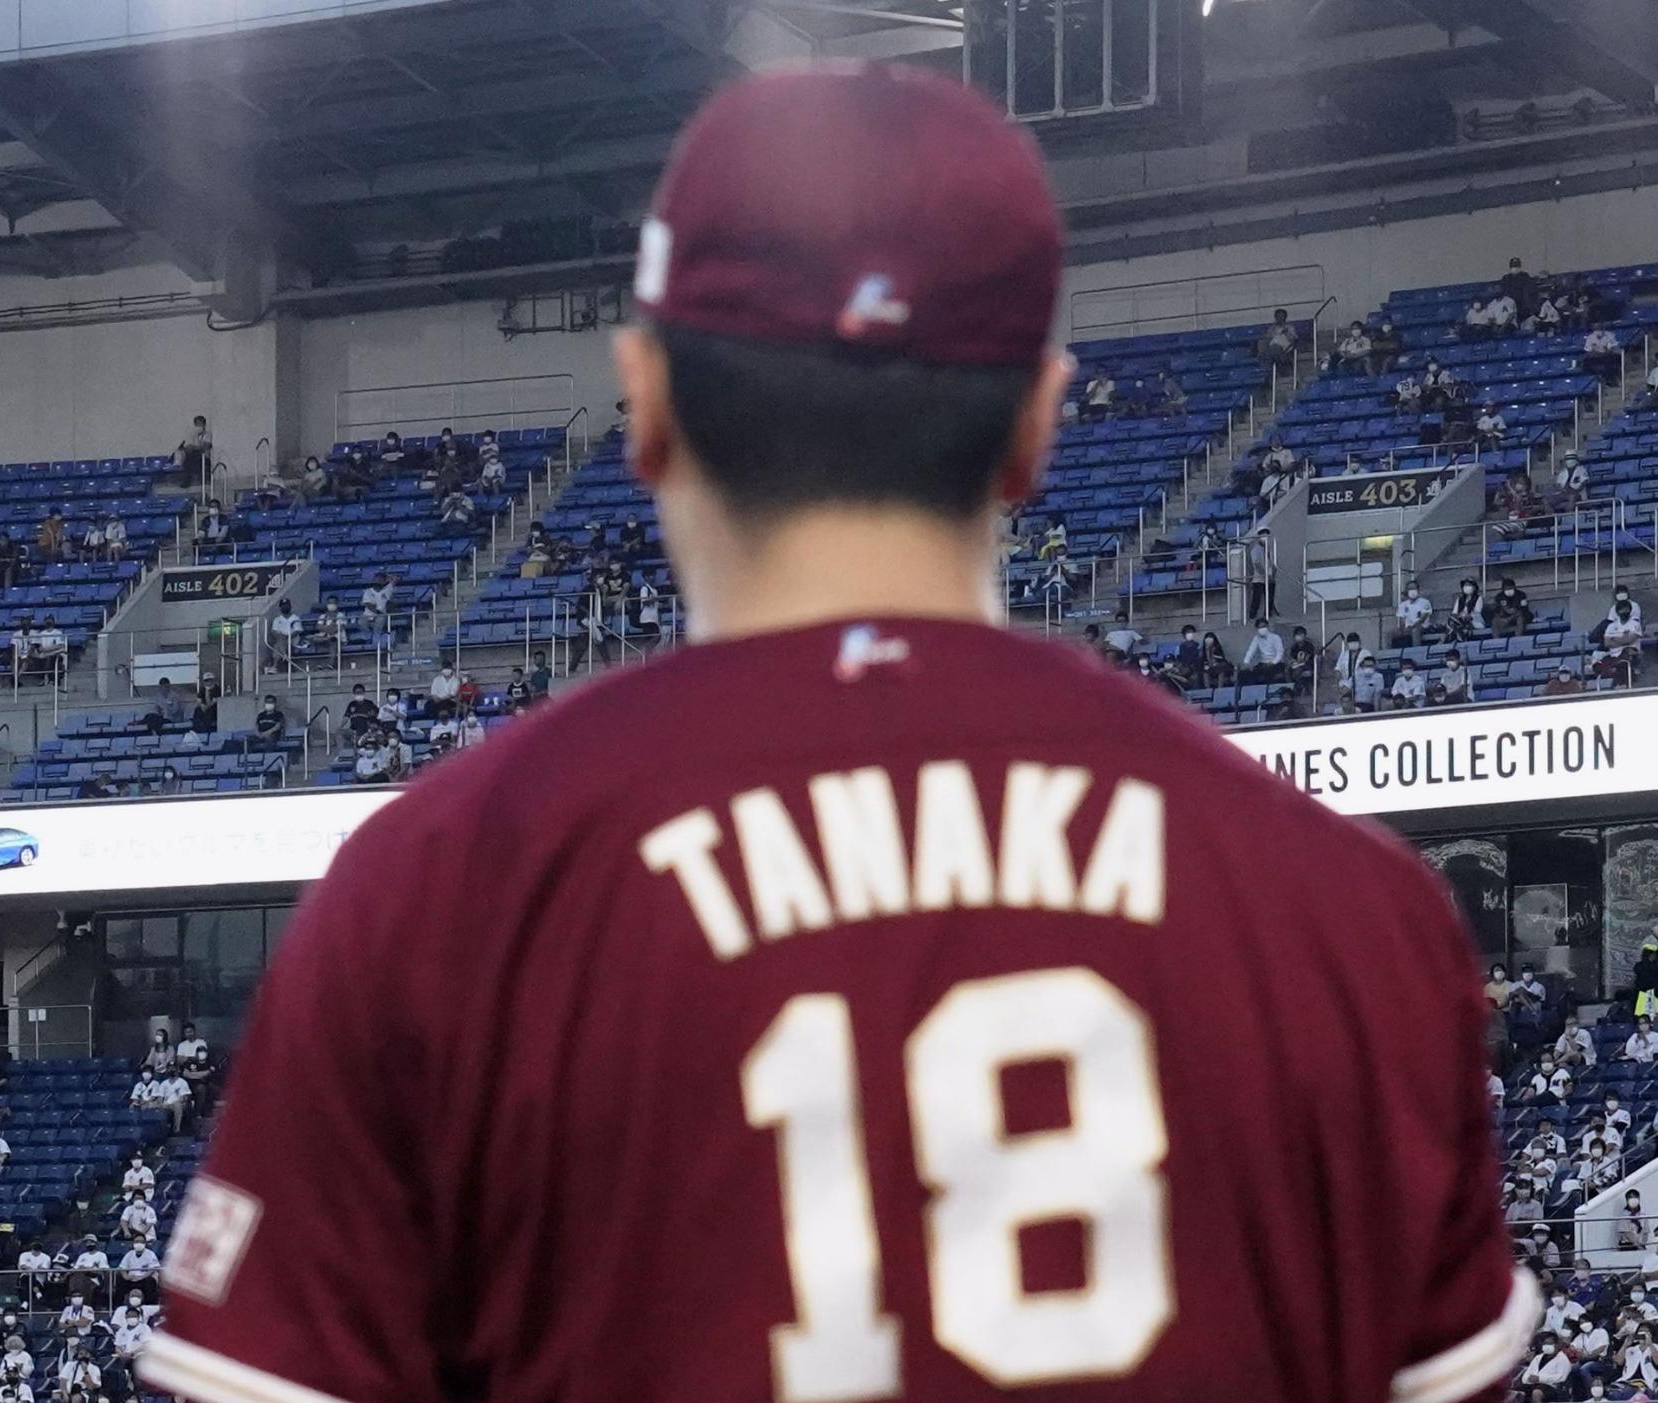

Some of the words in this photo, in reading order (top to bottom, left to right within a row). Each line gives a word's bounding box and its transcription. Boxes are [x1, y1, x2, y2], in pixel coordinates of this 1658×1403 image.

[1310, 490, 1353, 505] AISLE
[1359, 479, 1416, 505] 403
[164, 581, 202, 593] AISLE
[208, 572, 258, 595] 402
[1369, 723, 1616, 788] COLLECTION
[639, 759, 1166, 961] TANAKA
